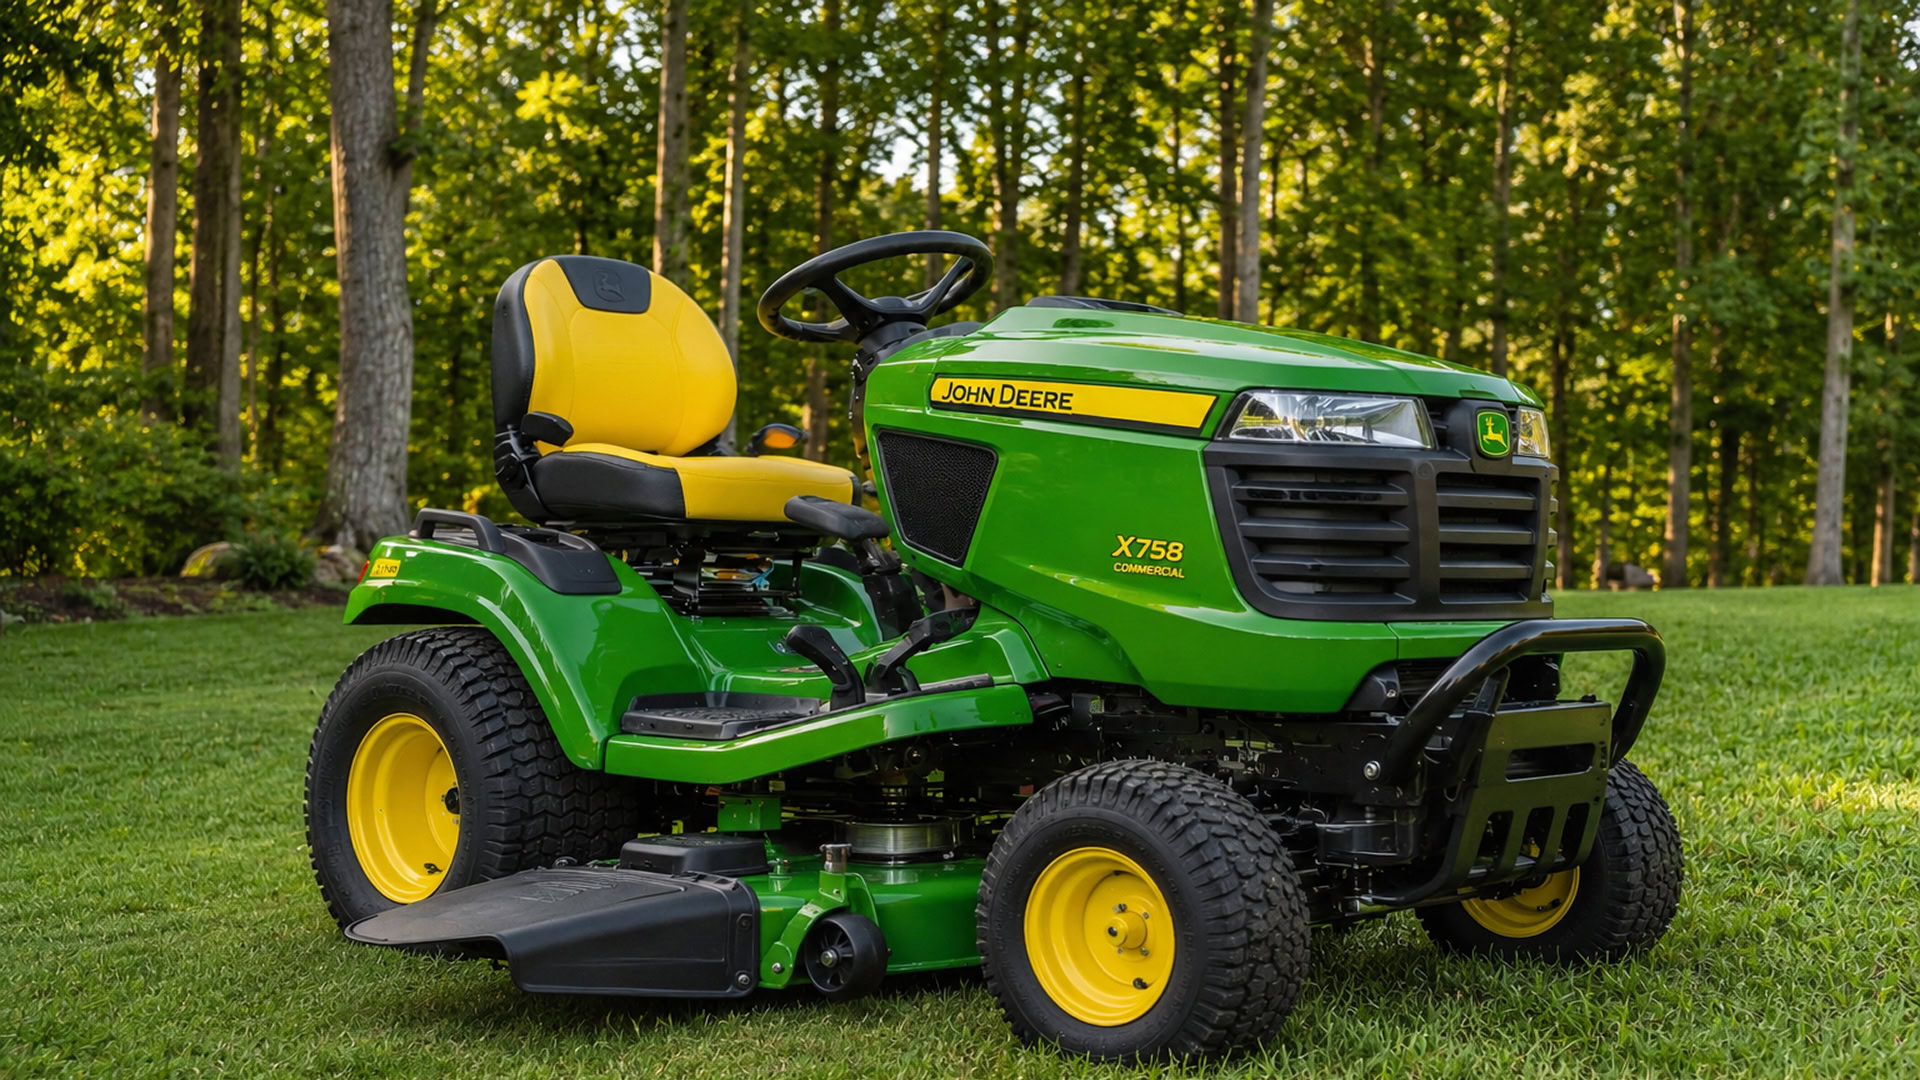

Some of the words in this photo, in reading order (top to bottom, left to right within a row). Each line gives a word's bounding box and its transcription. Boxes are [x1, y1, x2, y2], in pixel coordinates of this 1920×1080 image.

[942, 381, 995, 404] JOHN
[1000, 384, 1074, 411] DEERE
[1111, 535, 1184, 562] X758
[1113, 562, 1185, 578] COMMERCIAL
